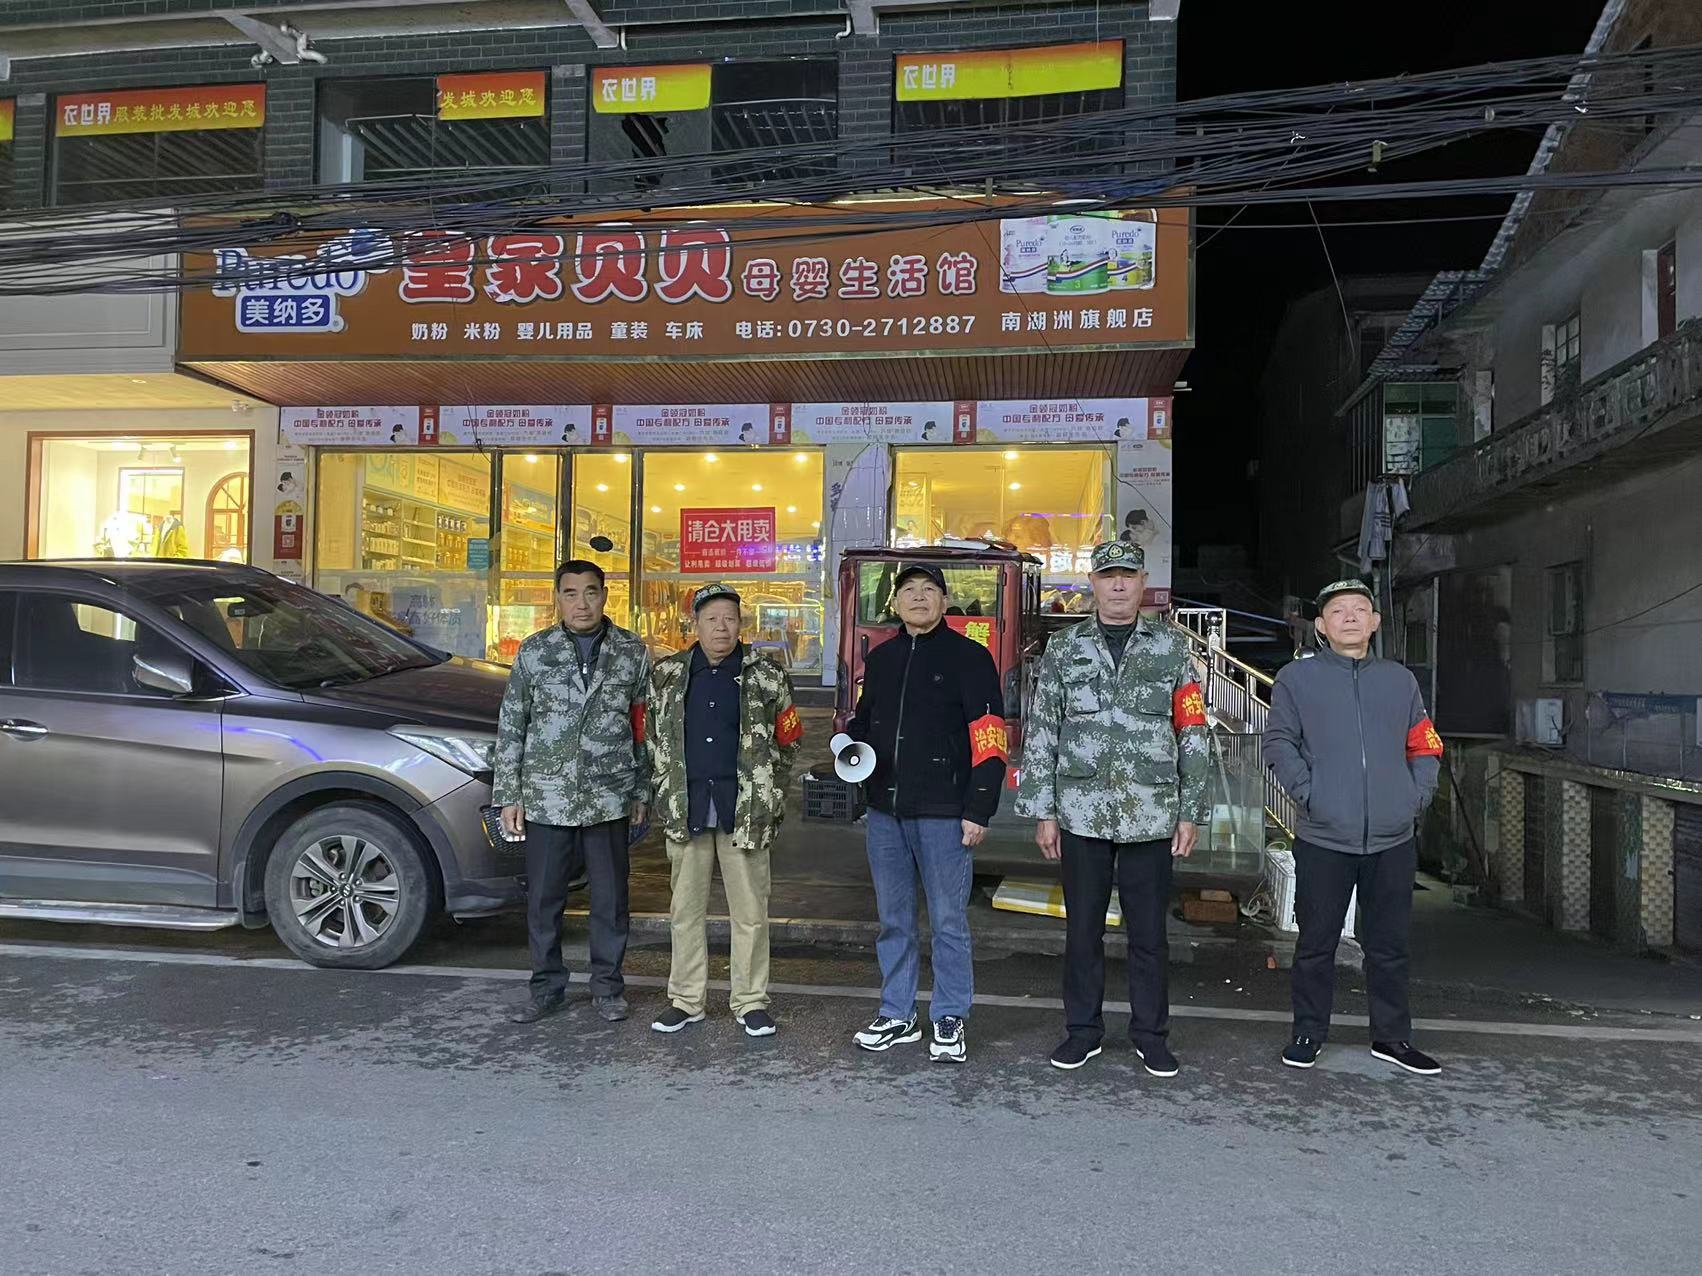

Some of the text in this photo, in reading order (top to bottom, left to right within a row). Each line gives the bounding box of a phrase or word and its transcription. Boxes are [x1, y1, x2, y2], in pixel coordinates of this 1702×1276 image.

[602, 76, 656, 102] 衣世界
[904, 63, 956, 89] 衣世界
[398, 221, 977, 304] 皇家贝贝 母婴生活馆
[245, 298, 325, 325] 美纳多
[411, 322, 449, 341] 奶粉
[463, 322, 500, 340] 米粉
[517, 322, 593, 340] 婴儿用品
[610, 321, 649, 340] 童装
[665, 321, 704, 340] 车床
[1001, 308, 1153, 332] 南湖洲旗舰店
[688, 519, 770, 543] 清仓大甩卖
[1182, 691, 1203, 717] 治安
